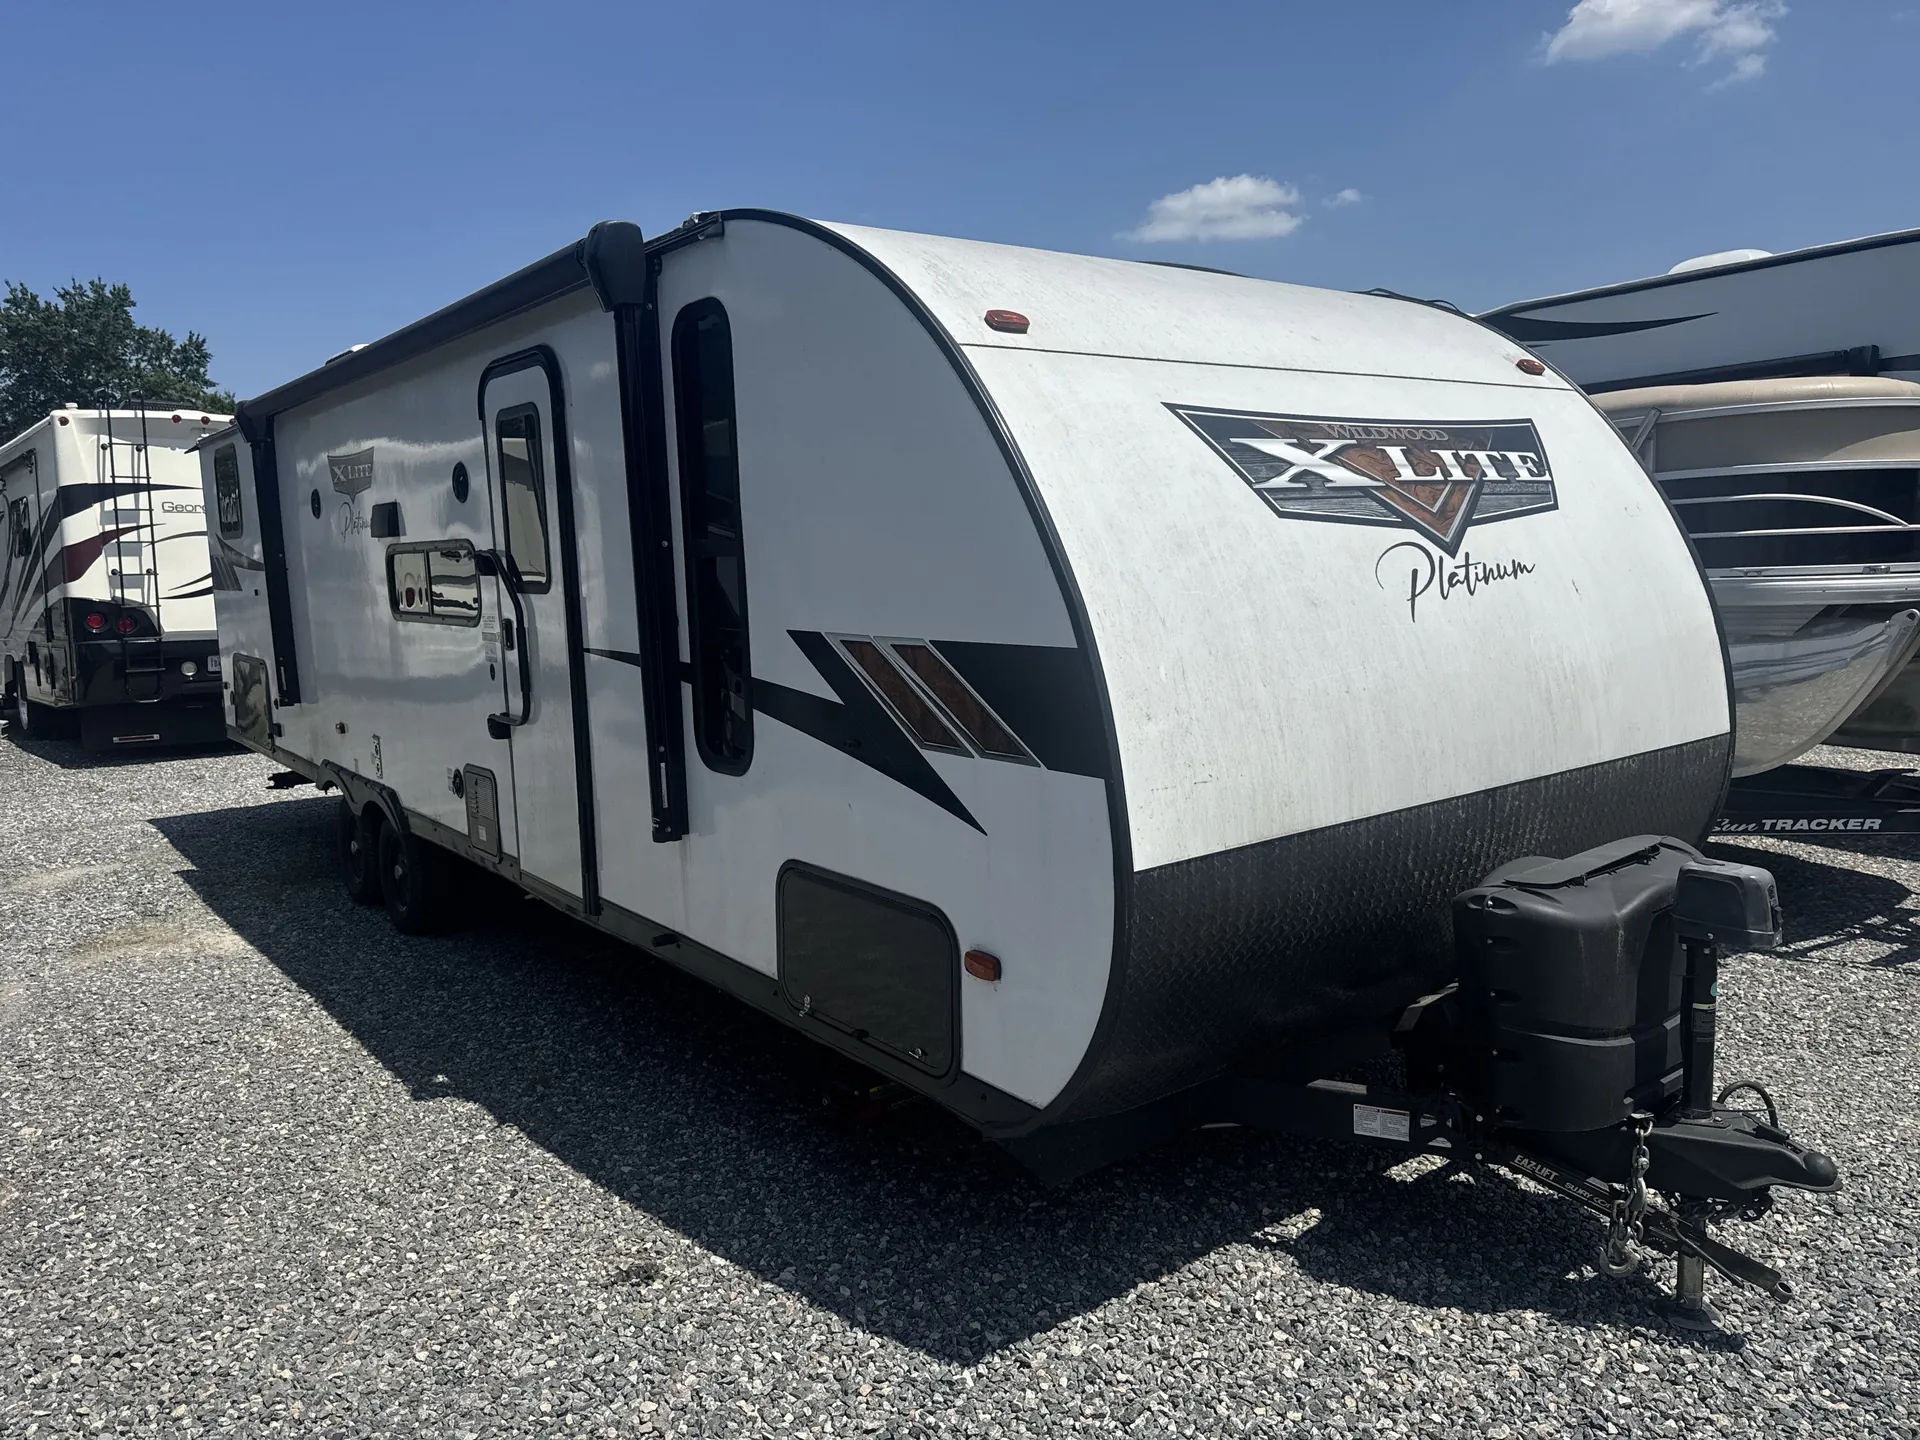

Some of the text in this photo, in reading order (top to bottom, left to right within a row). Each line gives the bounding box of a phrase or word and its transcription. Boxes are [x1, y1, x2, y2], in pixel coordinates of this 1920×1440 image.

[1319, 423, 1449, 441] WILDWOOD
[331, 463, 372, 484] X LITE
[1229, 437, 1553, 489] X LITE
[1375, 541, 1536, 623] Platinum
[1761, 818, 1882, 831] TRACKER
[1514, 1154, 1559, 1181] EAZ-LIFT
